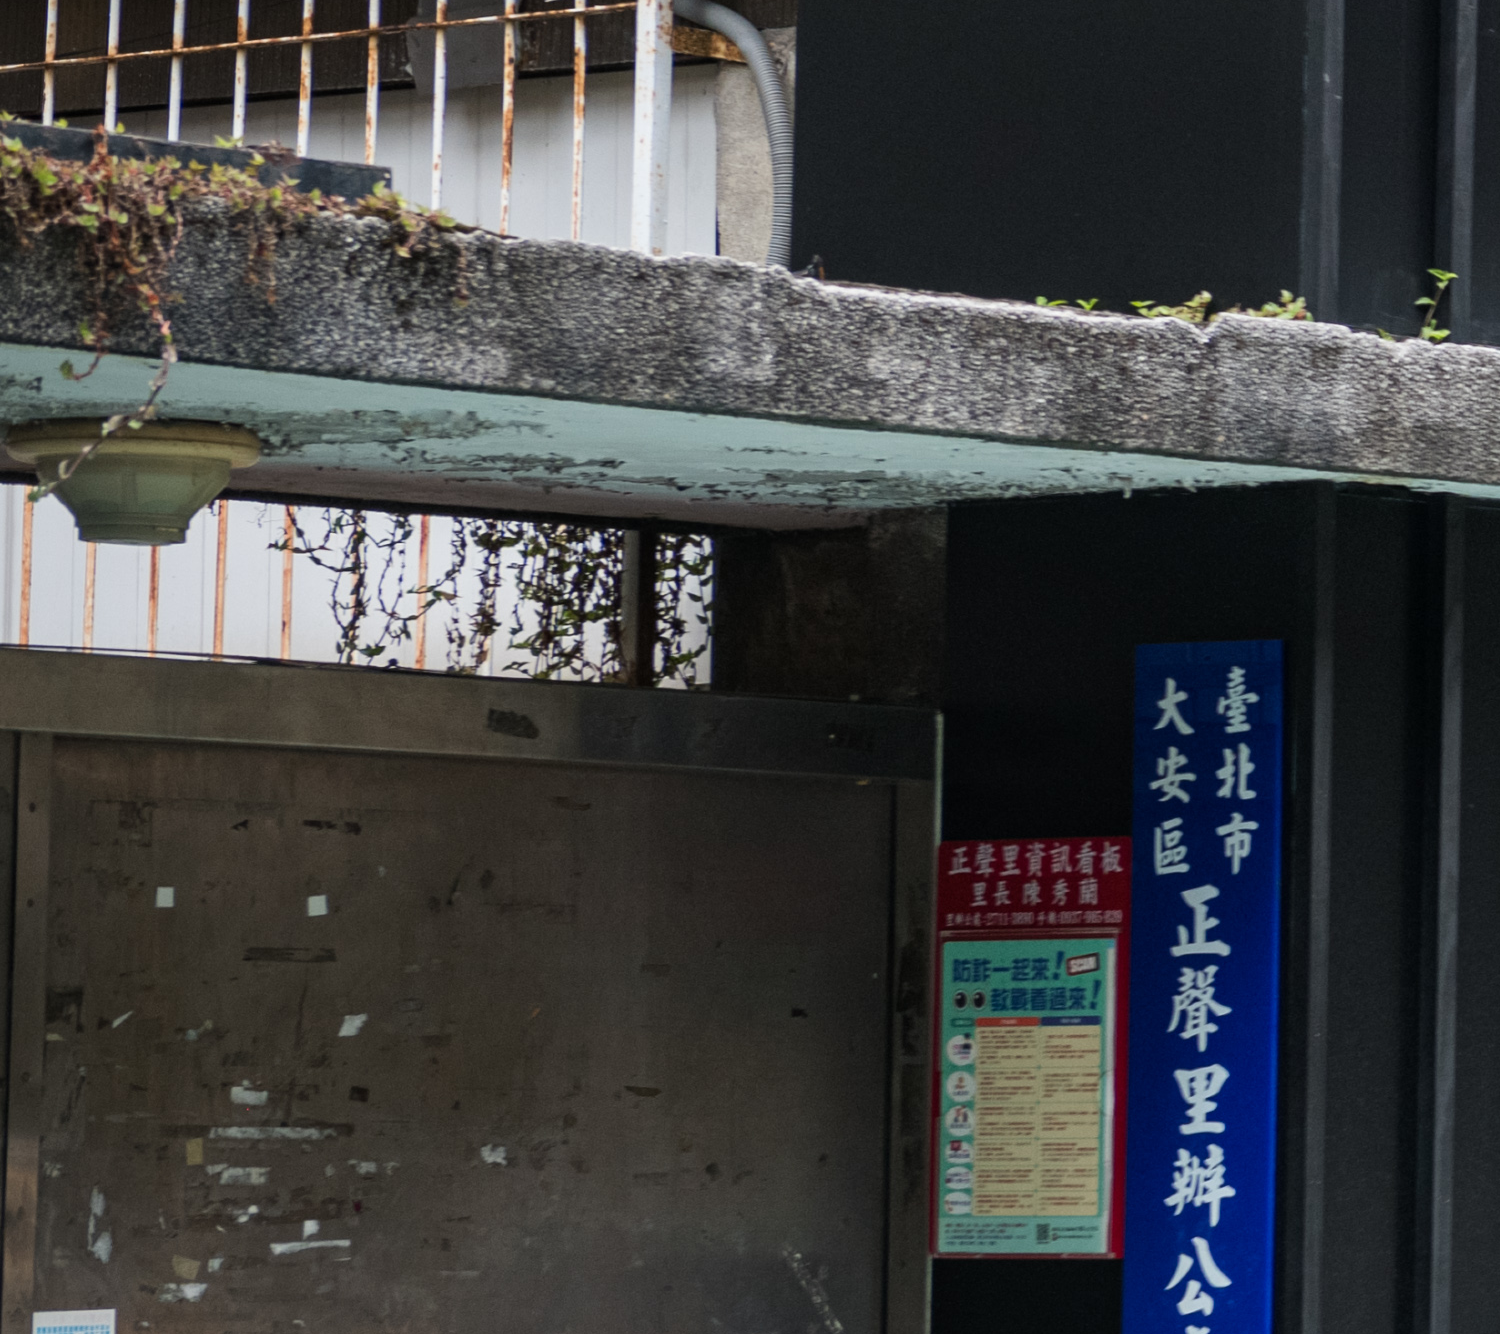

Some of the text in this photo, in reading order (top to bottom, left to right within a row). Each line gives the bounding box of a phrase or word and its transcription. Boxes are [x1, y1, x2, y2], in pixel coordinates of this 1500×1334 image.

[947, 840, 1124, 878] 正聲里資訊看板
[1149, 677, 1197, 876] 大安區
[1215, 666, 1260, 875] 臺北市
